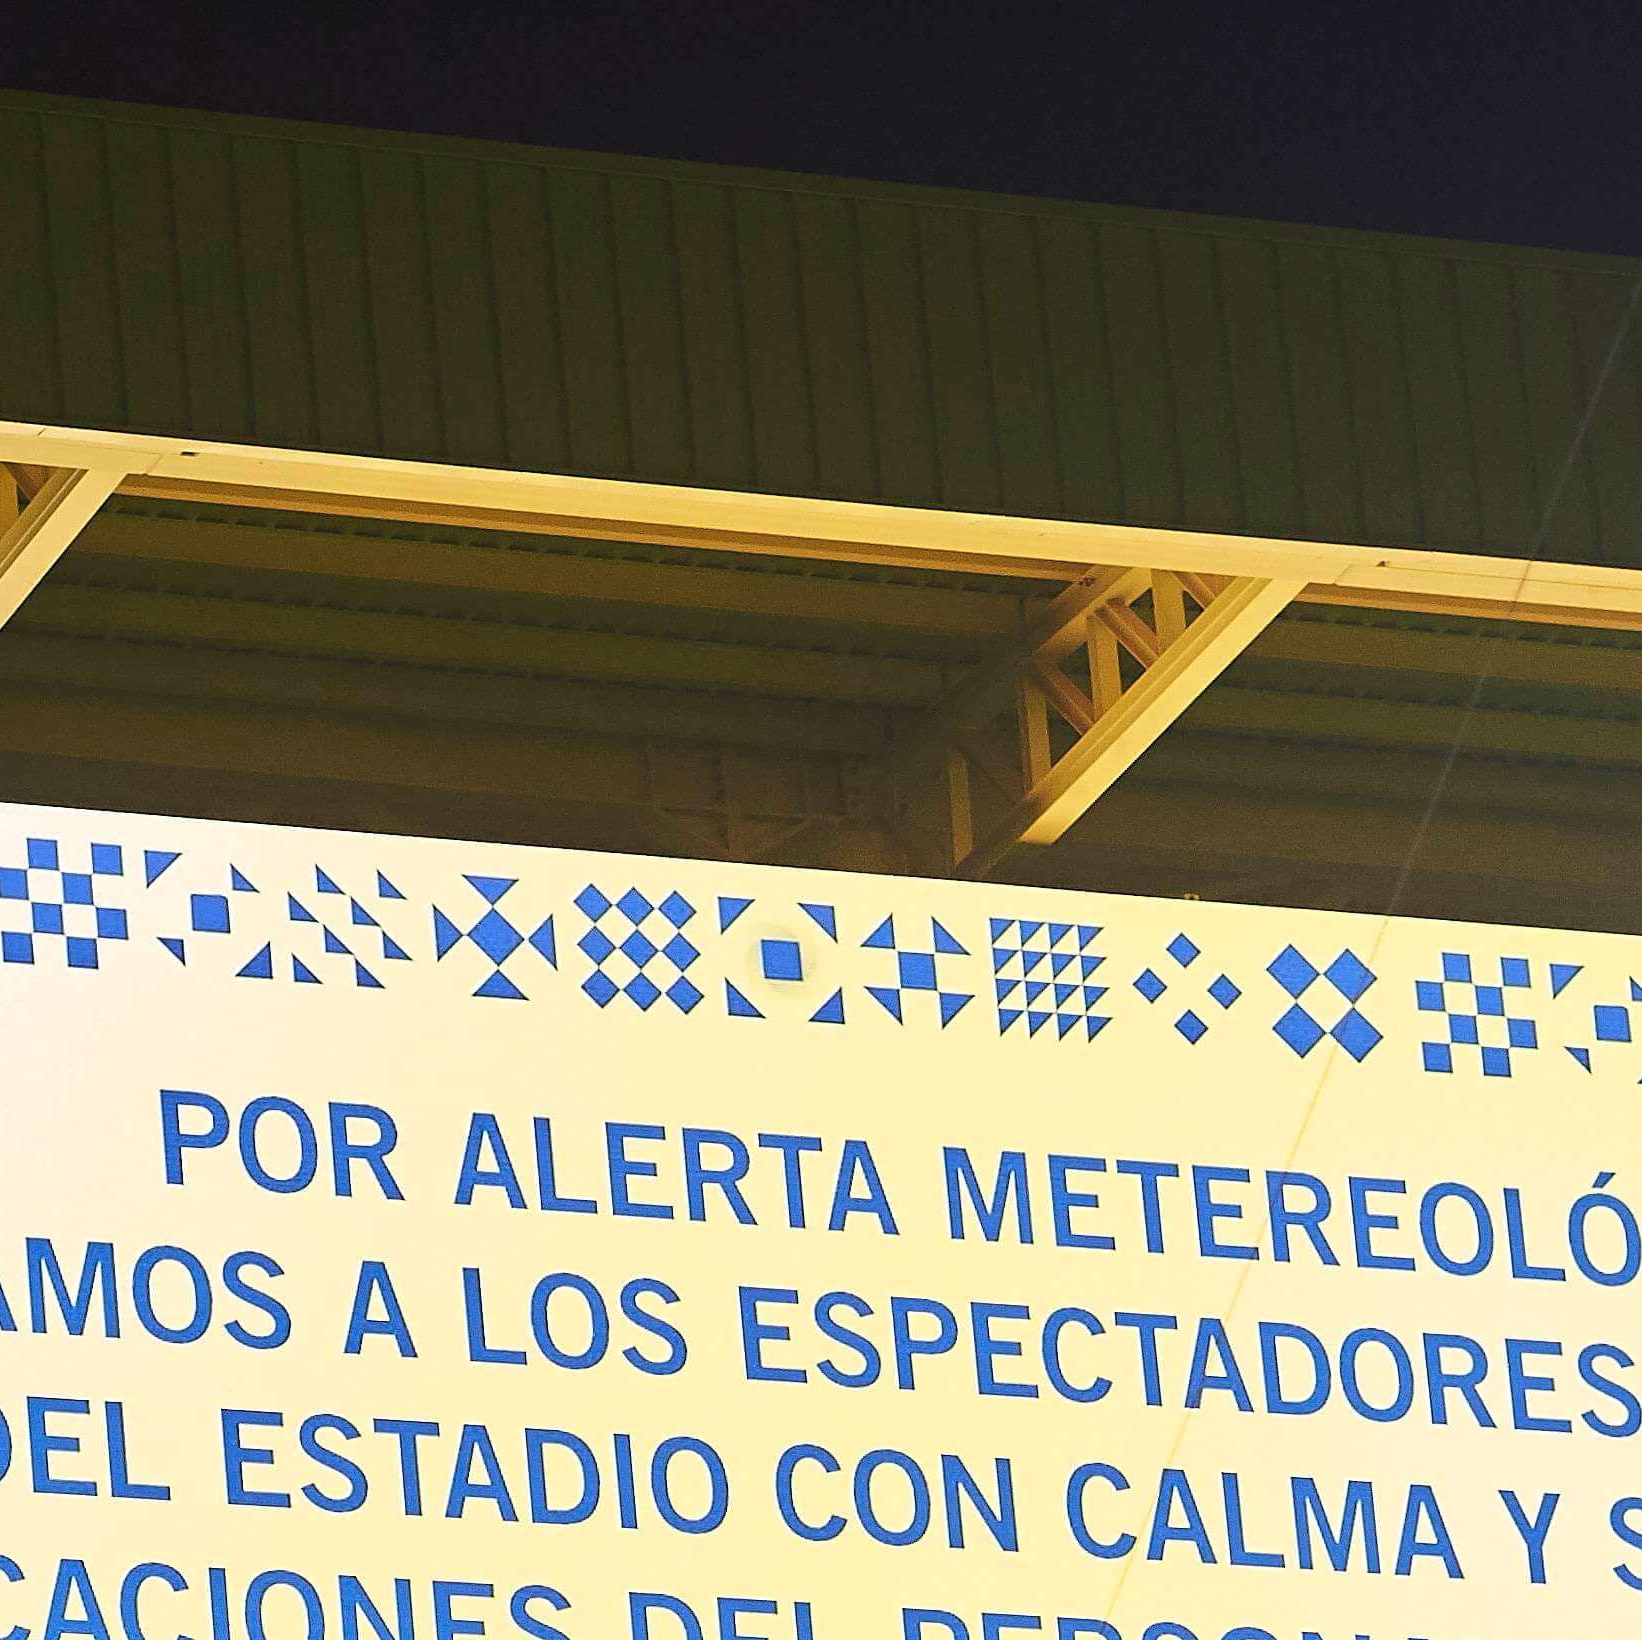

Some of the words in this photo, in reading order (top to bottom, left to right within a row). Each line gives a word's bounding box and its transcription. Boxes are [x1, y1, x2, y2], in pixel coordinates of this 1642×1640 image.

[159, 1088, 406, 1201] POR
[453, 1111, 900, 1236] ALERTA
[343, 1260, 419, 1359] A
[462, 1267, 688, 1376] LOS
[738, 1285, 1642, 1438] ESPECTADORES
[220, 1408, 729, 1535] ESTADIO
[775, 1443, 1019, 1553] CON
[1066, 1462, 1465, 1580] CALMA
[1497, 1489, 1561, 1585] Y
